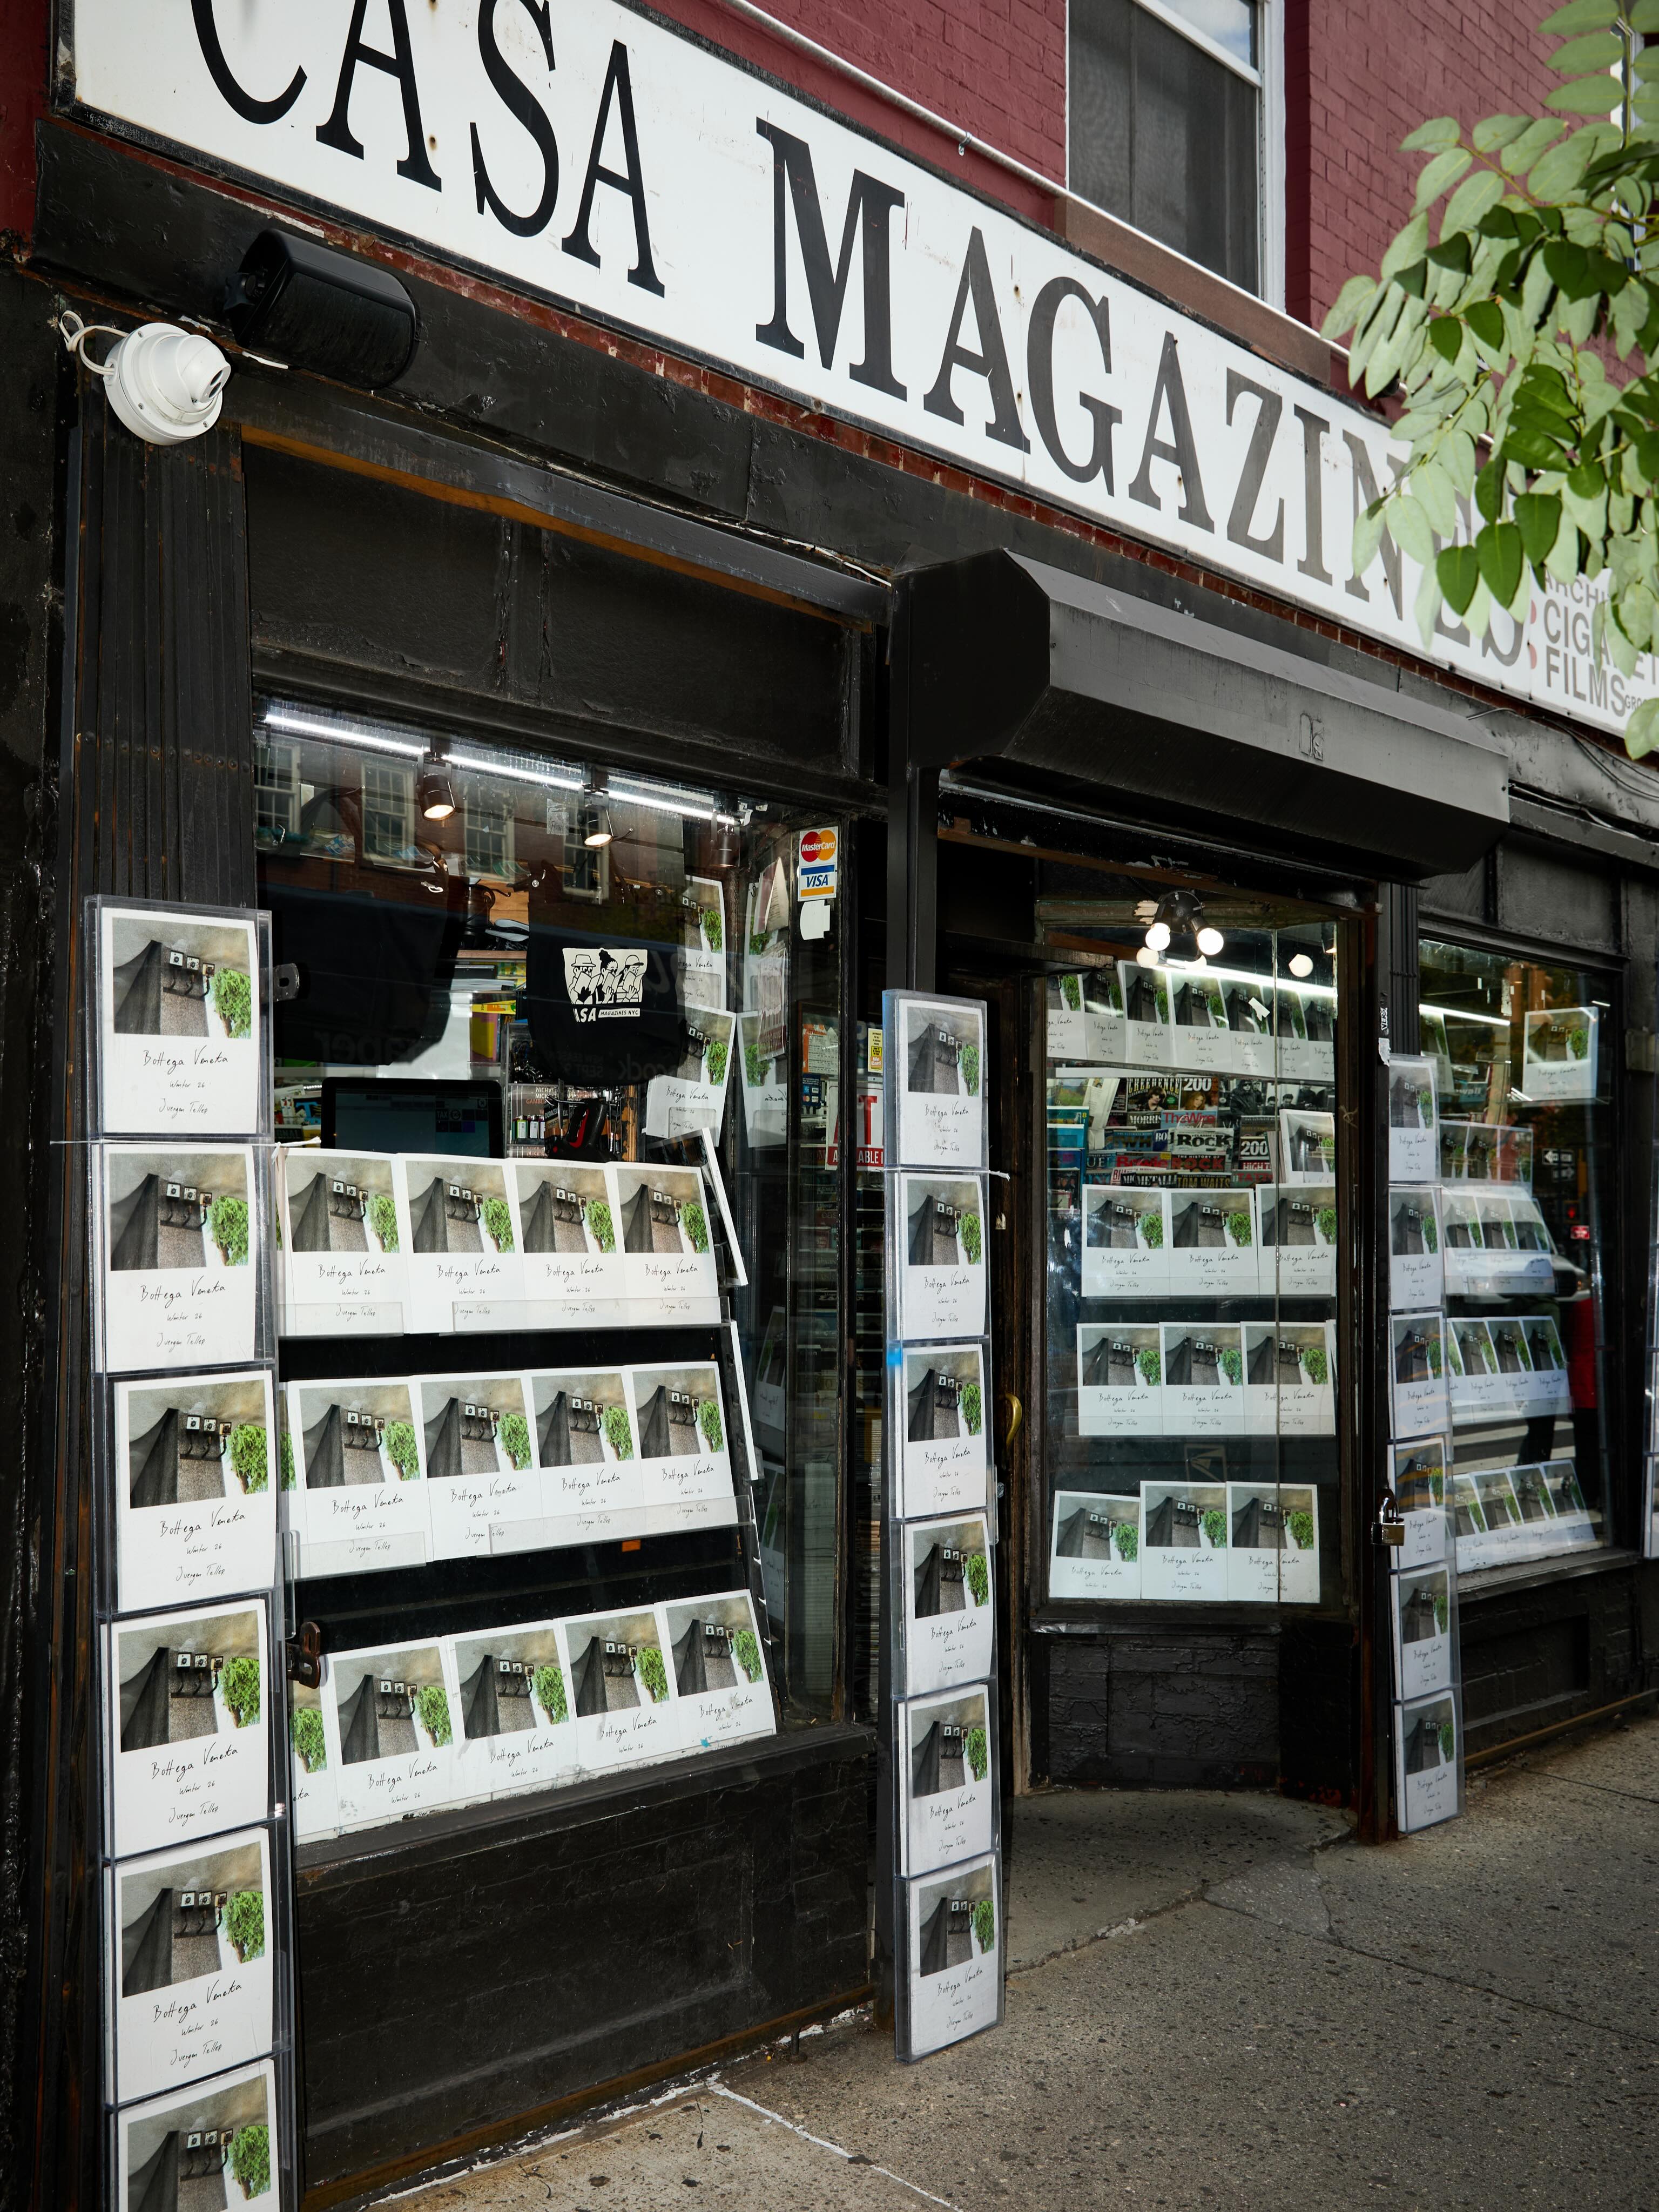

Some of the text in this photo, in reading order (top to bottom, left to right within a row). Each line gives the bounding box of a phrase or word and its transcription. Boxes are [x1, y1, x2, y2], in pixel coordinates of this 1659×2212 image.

[756, 117, 1524, 666] MAGAZIN
[1546, 645, 1626, 717] FILMS
[801, 841, 835, 852] MasterCard
[806, 874, 829, 888] VISA
[143, 1044, 229, 1074] Bottega Veneta
[169, 1079, 191, 1088] Winter
[1183, 1078, 1212, 1091] 200
[689, 1087, 709, 1101] Veneta
[158, 1099, 185, 1118] Juergen
[544, 1108, 559, 1119] DURACEL
[925, 1100, 969, 1122] Bottega Veneta
[1176, 1134, 1232, 1148] ROCK
[1240, 1141, 1268, 1156] 200
[1171, 1157, 1224, 1170] ROCK
[1177, 1176, 1198, 1188] TOM
[1200, 1177, 1231, 1188] WAITS
[318, 1258, 386, 1284] Bottega Veneta
[436, 1258, 501, 1284] Bottega Veneta
[545, 1258, 604, 1283] Bottega Veneta
[644, 1258, 698, 1282] Bottega Veneta
[139, 1275, 226, 1308] Bottega Veneta
[923, 1270, 970, 1294] Bottega Veneta
[166, 1313, 188, 1321] Winter
[156, 1333, 181, 1352] Juergen
[1263, 1392, 1289, 1405] Bottga
[925, 1442, 970, 1468] Bottega Veneta
[561, 1468, 621, 1495] Bottega Veneta
[662, 1460, 714, 1485] Bottega Veneta
[449, 1478, 516, 1507] Bottega Veneta
[331, 1489, 403, 1519] Bottega Veneta
[159, 1505, 246, 1542] Bottega Veneta
[464, 1527, 484, 1543] Juergen
[186, 1545, 208, 1554] Winter
[176, 1567, 201, 1585] Juergen
[930, 1615, 977, 1643] Bottega Veneta
[632, 1712, 657, 1731] Veneta
[698, 1703, 726, 1721] Bottega
[527, 1734, 554, 1754] Veneta
[151, 1741, 239, 1782] Bottega Veneta
[367, 1758, 437, 1792] Bottega Veneta
[179, 1783, 201, 1794] Winter
[391, 1794, 409, 1803] Winter
[929, 1791, 976, 1821] Bottega Veneta
[168, 1808, 195, 1826] Juergen
[937, 1964, 983, 1997] Bottega Veneta
[153, 1978, 242, 2024] Bottega Veneta
[181, 2018, 218, 2035] Winter 26
[170, 2050, 197, 2067] Juergen
